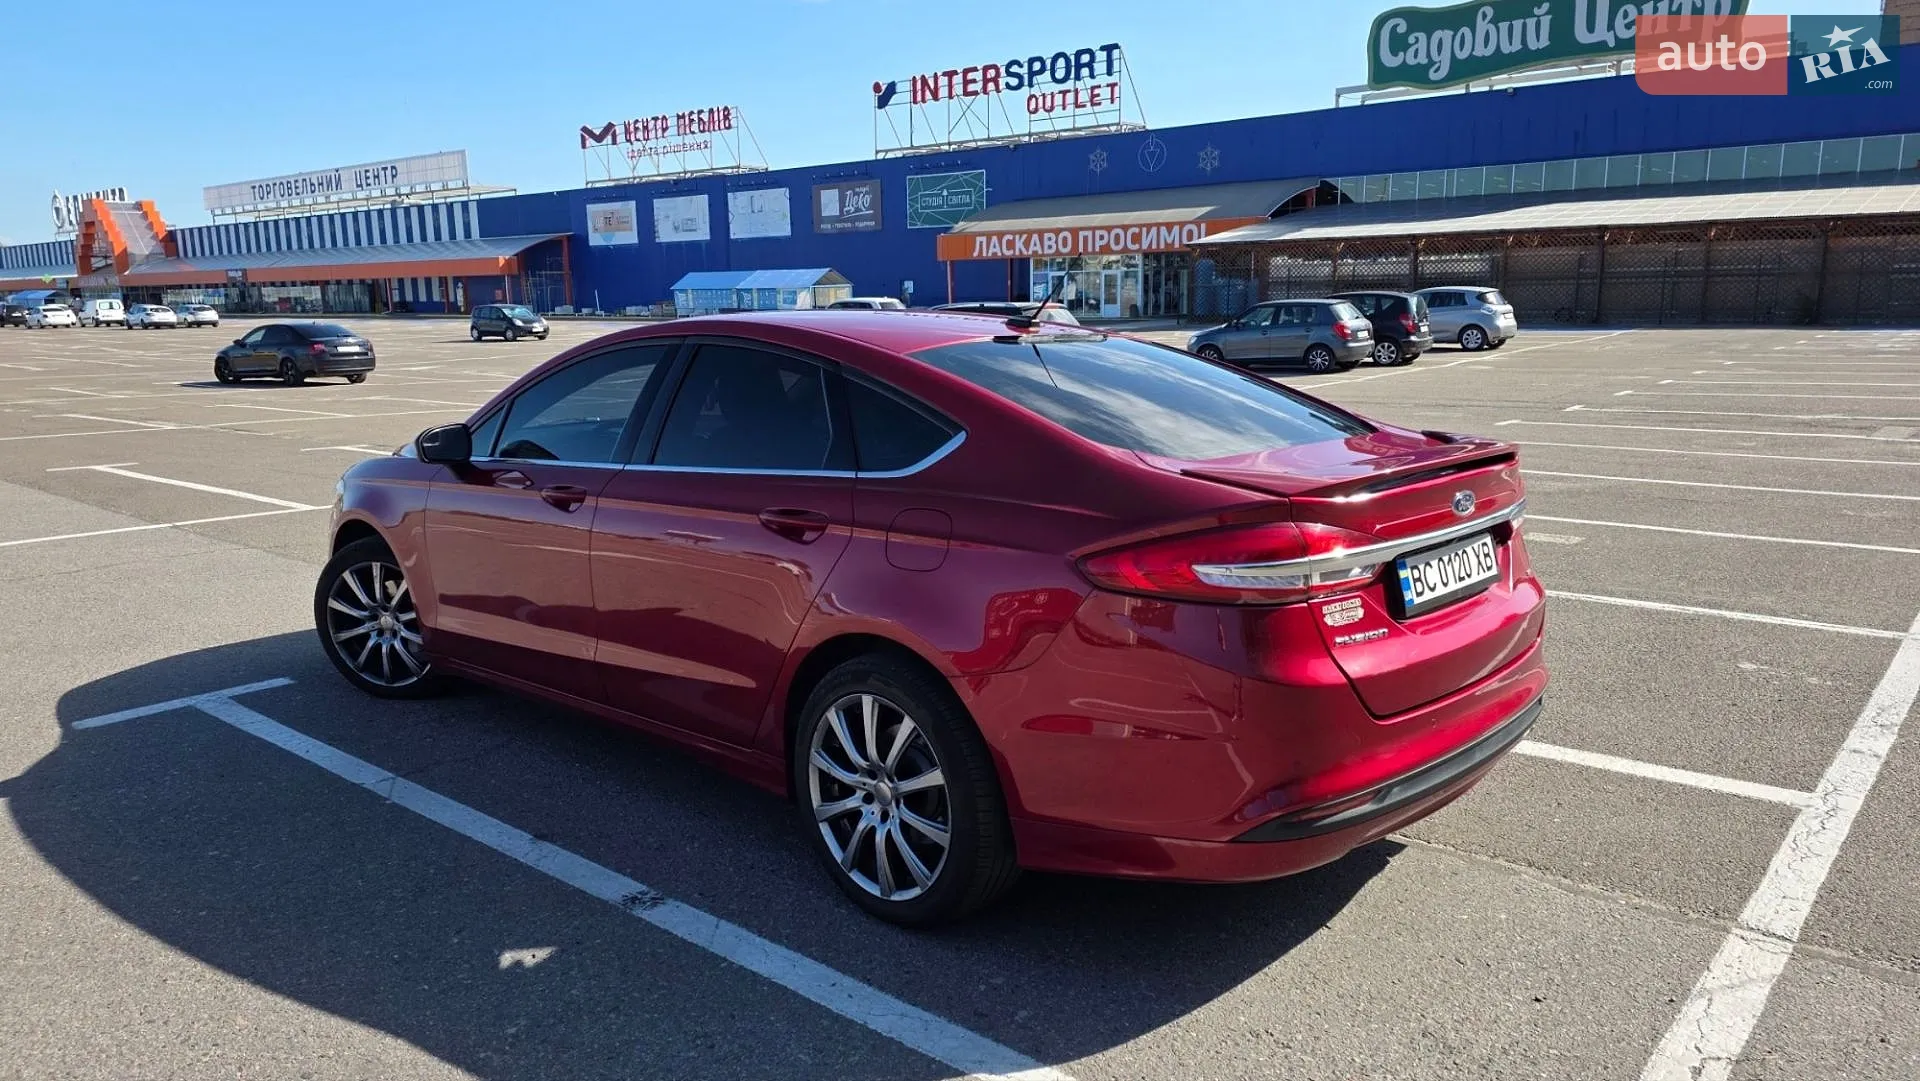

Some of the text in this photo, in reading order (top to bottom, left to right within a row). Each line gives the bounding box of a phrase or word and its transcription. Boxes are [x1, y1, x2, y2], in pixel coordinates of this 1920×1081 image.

[1379, 2, 1552, 81] Садовий
[911, 42, 1121, 105] INTERSPORT
[1026, 82, 1119, 115] OUTLET
[624, 115, 669, 145] ЦЕНТР
[676, 105, 732, 136] МЕБЛІВ
[251, 165, 398, 201] ТОРГОВЕЛЬНИЙ ЦЕНТР
[947, 194, 971, 205] СВІТЛА
[972, 230, 1073, 257] ЛАСКАВО
[1409, 542, 1493, 598] BC 0120 XB
